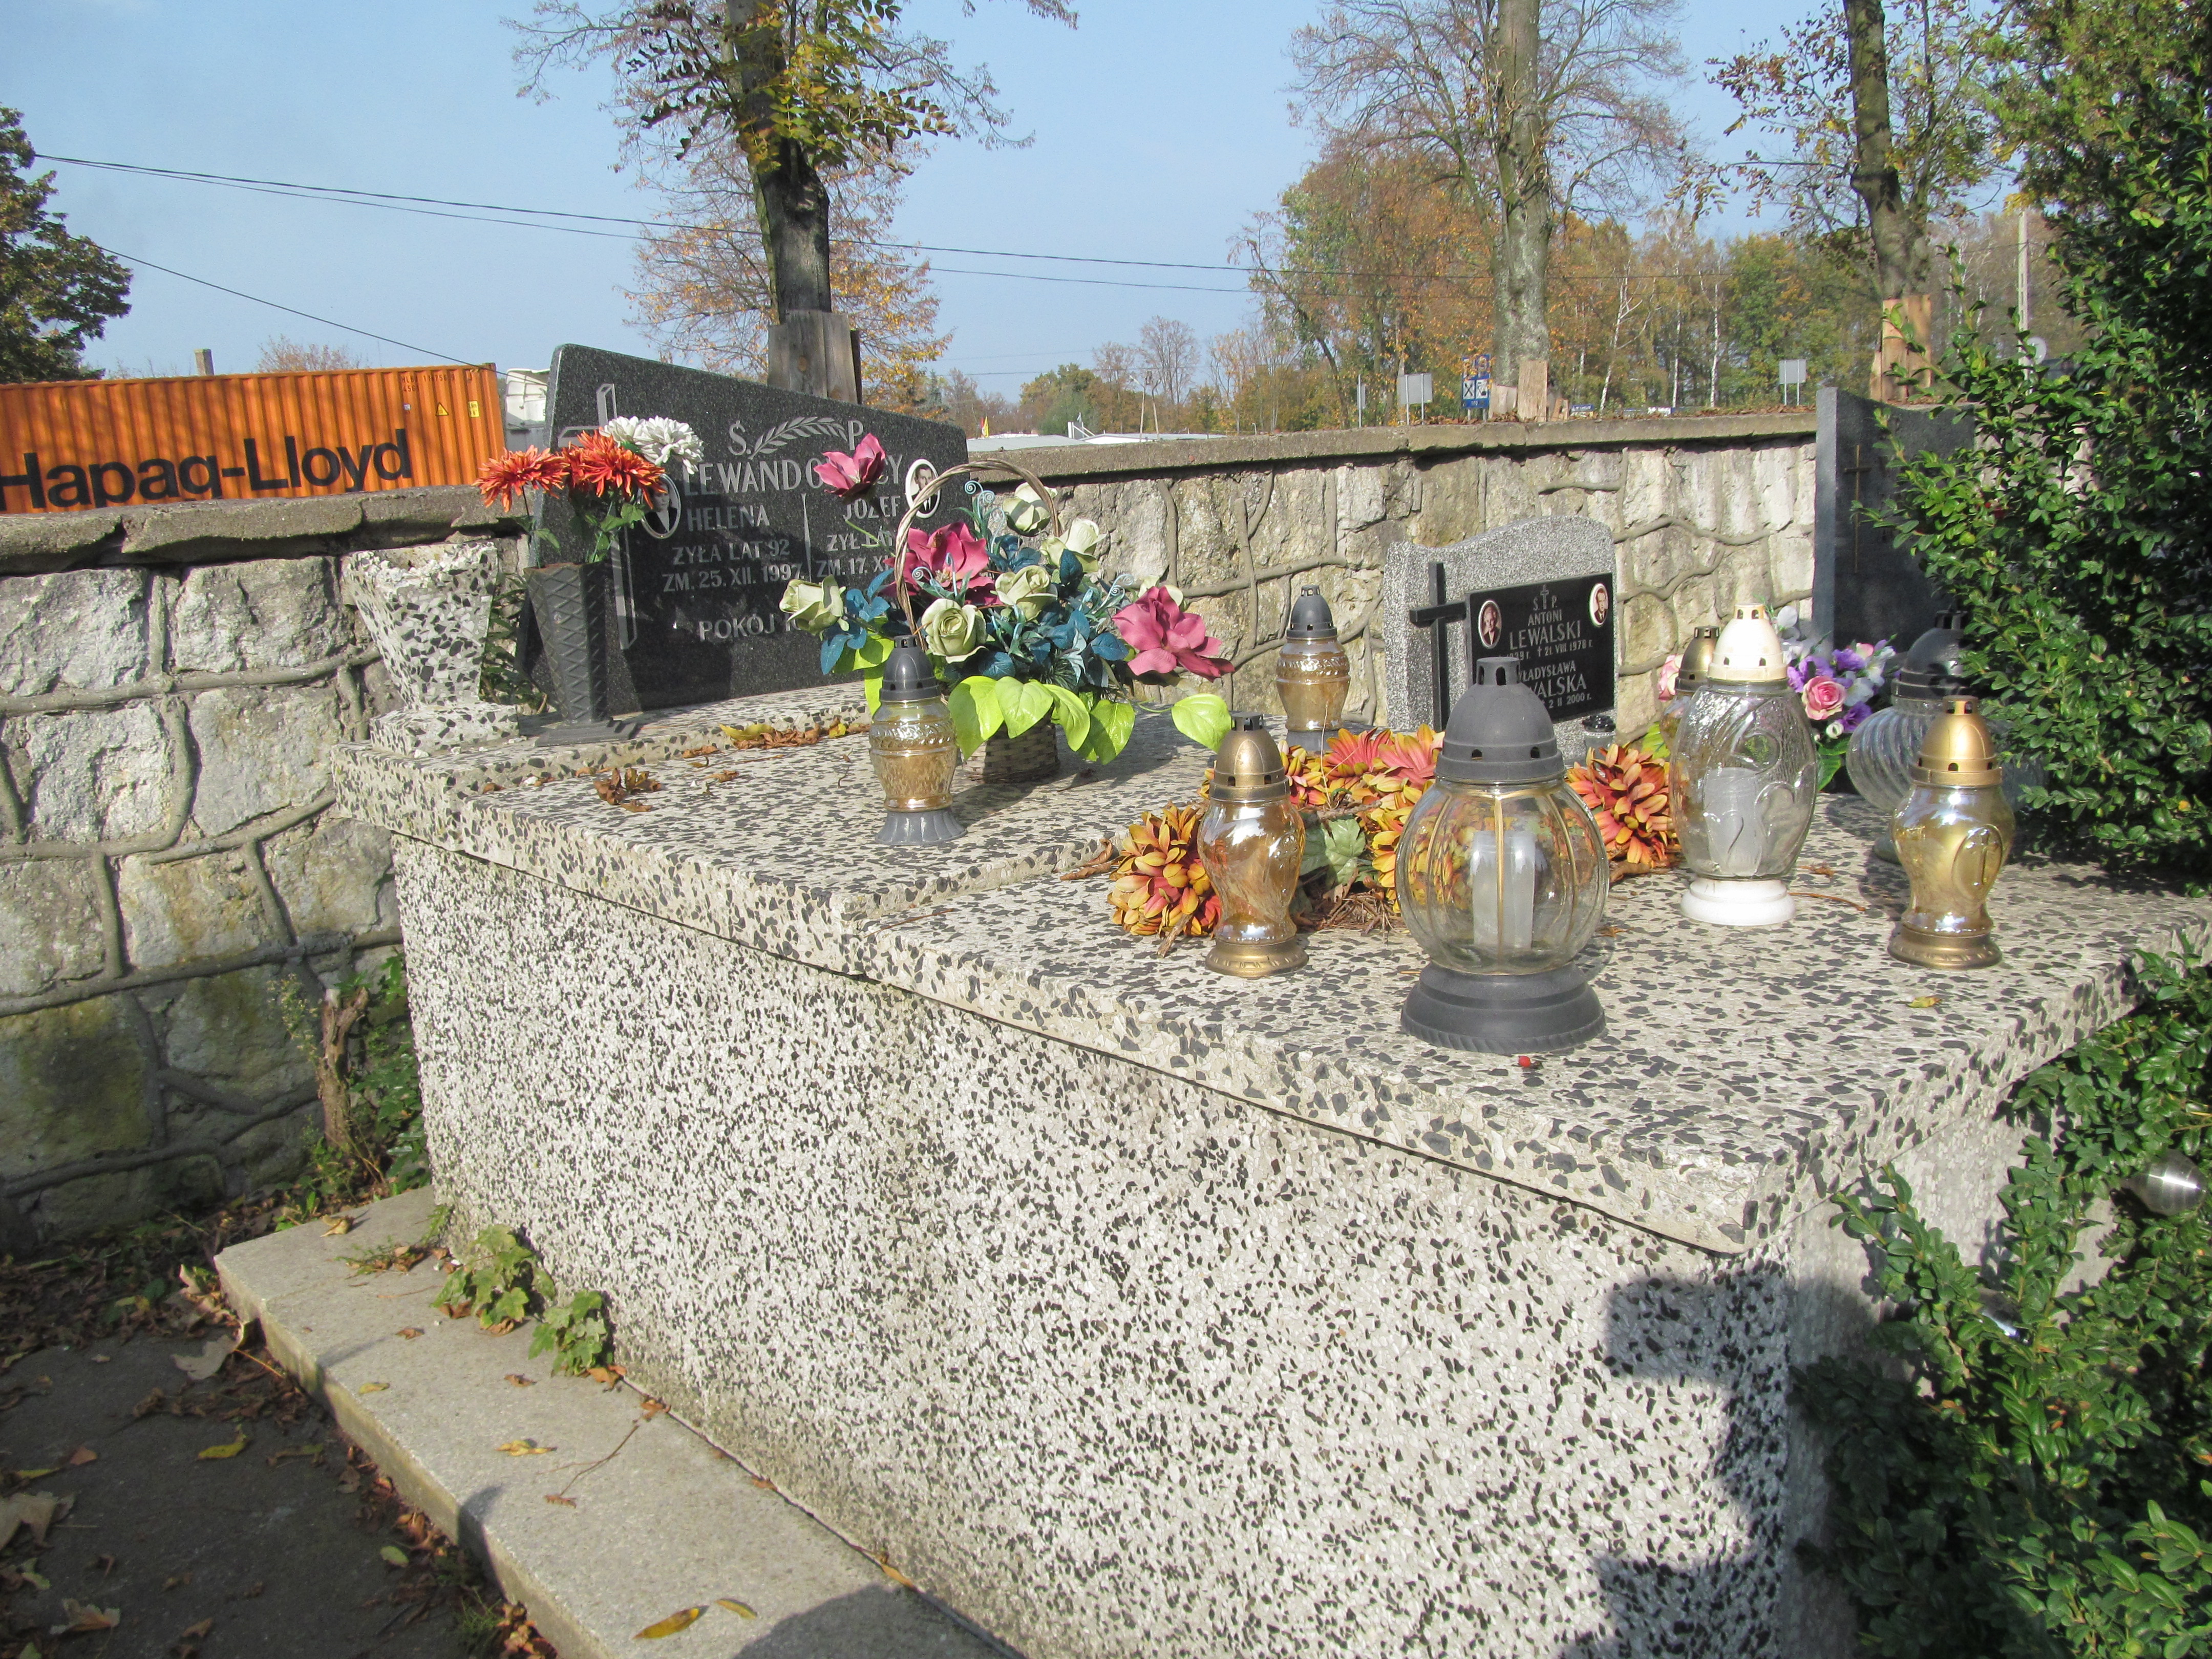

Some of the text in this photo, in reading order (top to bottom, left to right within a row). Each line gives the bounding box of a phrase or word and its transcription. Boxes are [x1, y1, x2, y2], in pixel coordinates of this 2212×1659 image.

[0, 429, 411, 510] Hapag-Lloyd
[687, 504, 770, 531] HELENA
[728, 541, 763, 561] LAT
[768, 539, 790, 557] 92
[699, 570, 727, 588] 25.
[729, 567, 756, 586] XII.
[698, 610, 775, 641] POKÓJ
[1528, 609, 1562, 626] ANTONI
[1510, 620, 1581, 650] LEWALSKI
[1569, 639, 1587, 651] 1978
[1567, 692, 1585, 705] 2000
